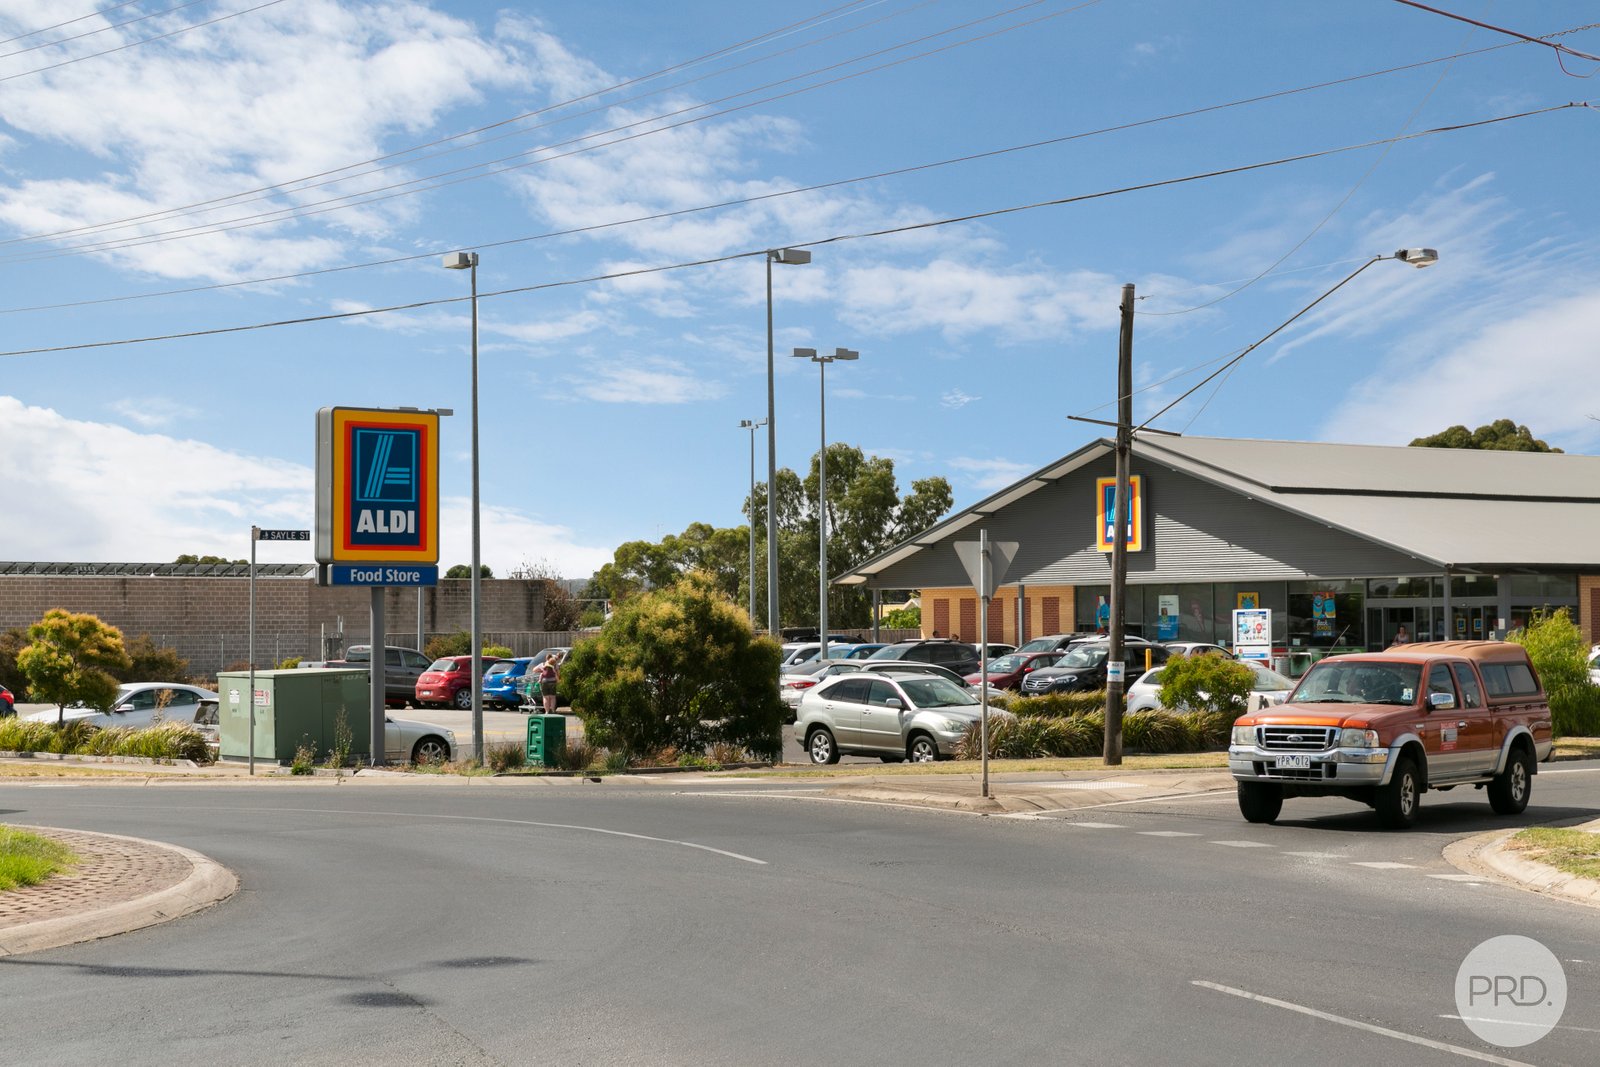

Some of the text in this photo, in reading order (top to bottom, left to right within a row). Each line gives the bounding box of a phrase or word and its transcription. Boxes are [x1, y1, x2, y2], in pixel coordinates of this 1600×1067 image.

[356, 509, 415, 533] ALDI
[270, 531, 310, 540] SAYLE ST
[1106, 524, 1132, 537] AI
[350, 568, 421, 582] Food Store
[1295, 756, 1309, 766] 012
